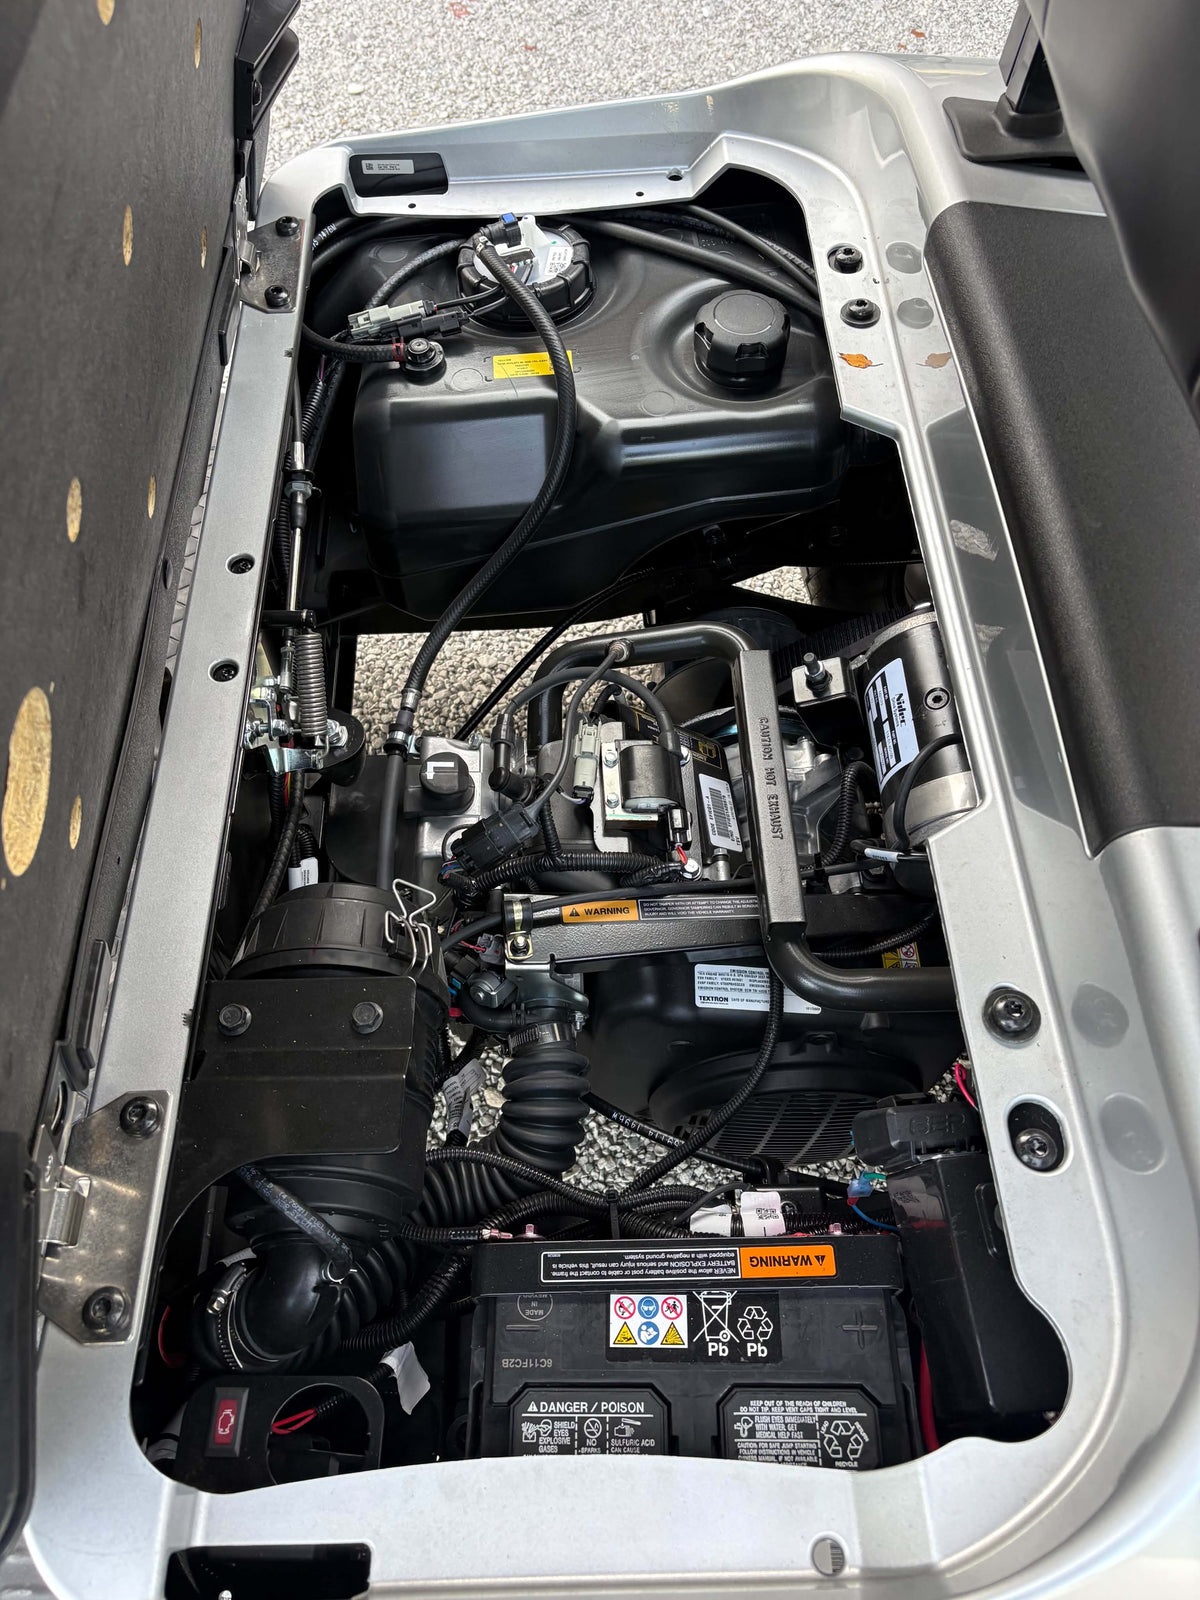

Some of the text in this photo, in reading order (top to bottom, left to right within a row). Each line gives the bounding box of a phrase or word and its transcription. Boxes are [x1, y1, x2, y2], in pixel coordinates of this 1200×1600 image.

[895, 692, 907, 727] Nidec
[758, 716, 784, 841] CAUTION HOT EXHAUST
[584, 906, 630, 916] WARNING
[309, 1216, 325, 1230] FUEL
[645, 1252, 665, 1260] ground
[666, 1252, 690, 1260] negative
[708, 1251, 734, 1259] equipped
[608, 1261, 619, 1269] can
[657, 1260, 668, 1268] and
[669, 1260, 706, 1268] EXPLOSION
[706, 1259, 735, 1267] BATTERY
[750, 1255, 813, 1268] WARNING
[551, 1267, 736, 1278] NEVER allow the positive battery post or cable to contact the frame.
[708, 1341, 729, 1357] Pb
[746, 1341, 768, 1358] Pb
[501, 1358, 553, 1368] 6C11FC2B
[540, 1401, 644, 1413] DANGER / POISON
[553, 1421, 575, 1429] SHIELD
[553, 1429, 569, 1437] EYES
[539, 1437, 571, 1445] EXPLOSIVE
[586, 1438, 597, 1446] NO
[610, 1438, 655, 1447] SULFURIC ACID
[538, 1445, 558, 1453] GASES
